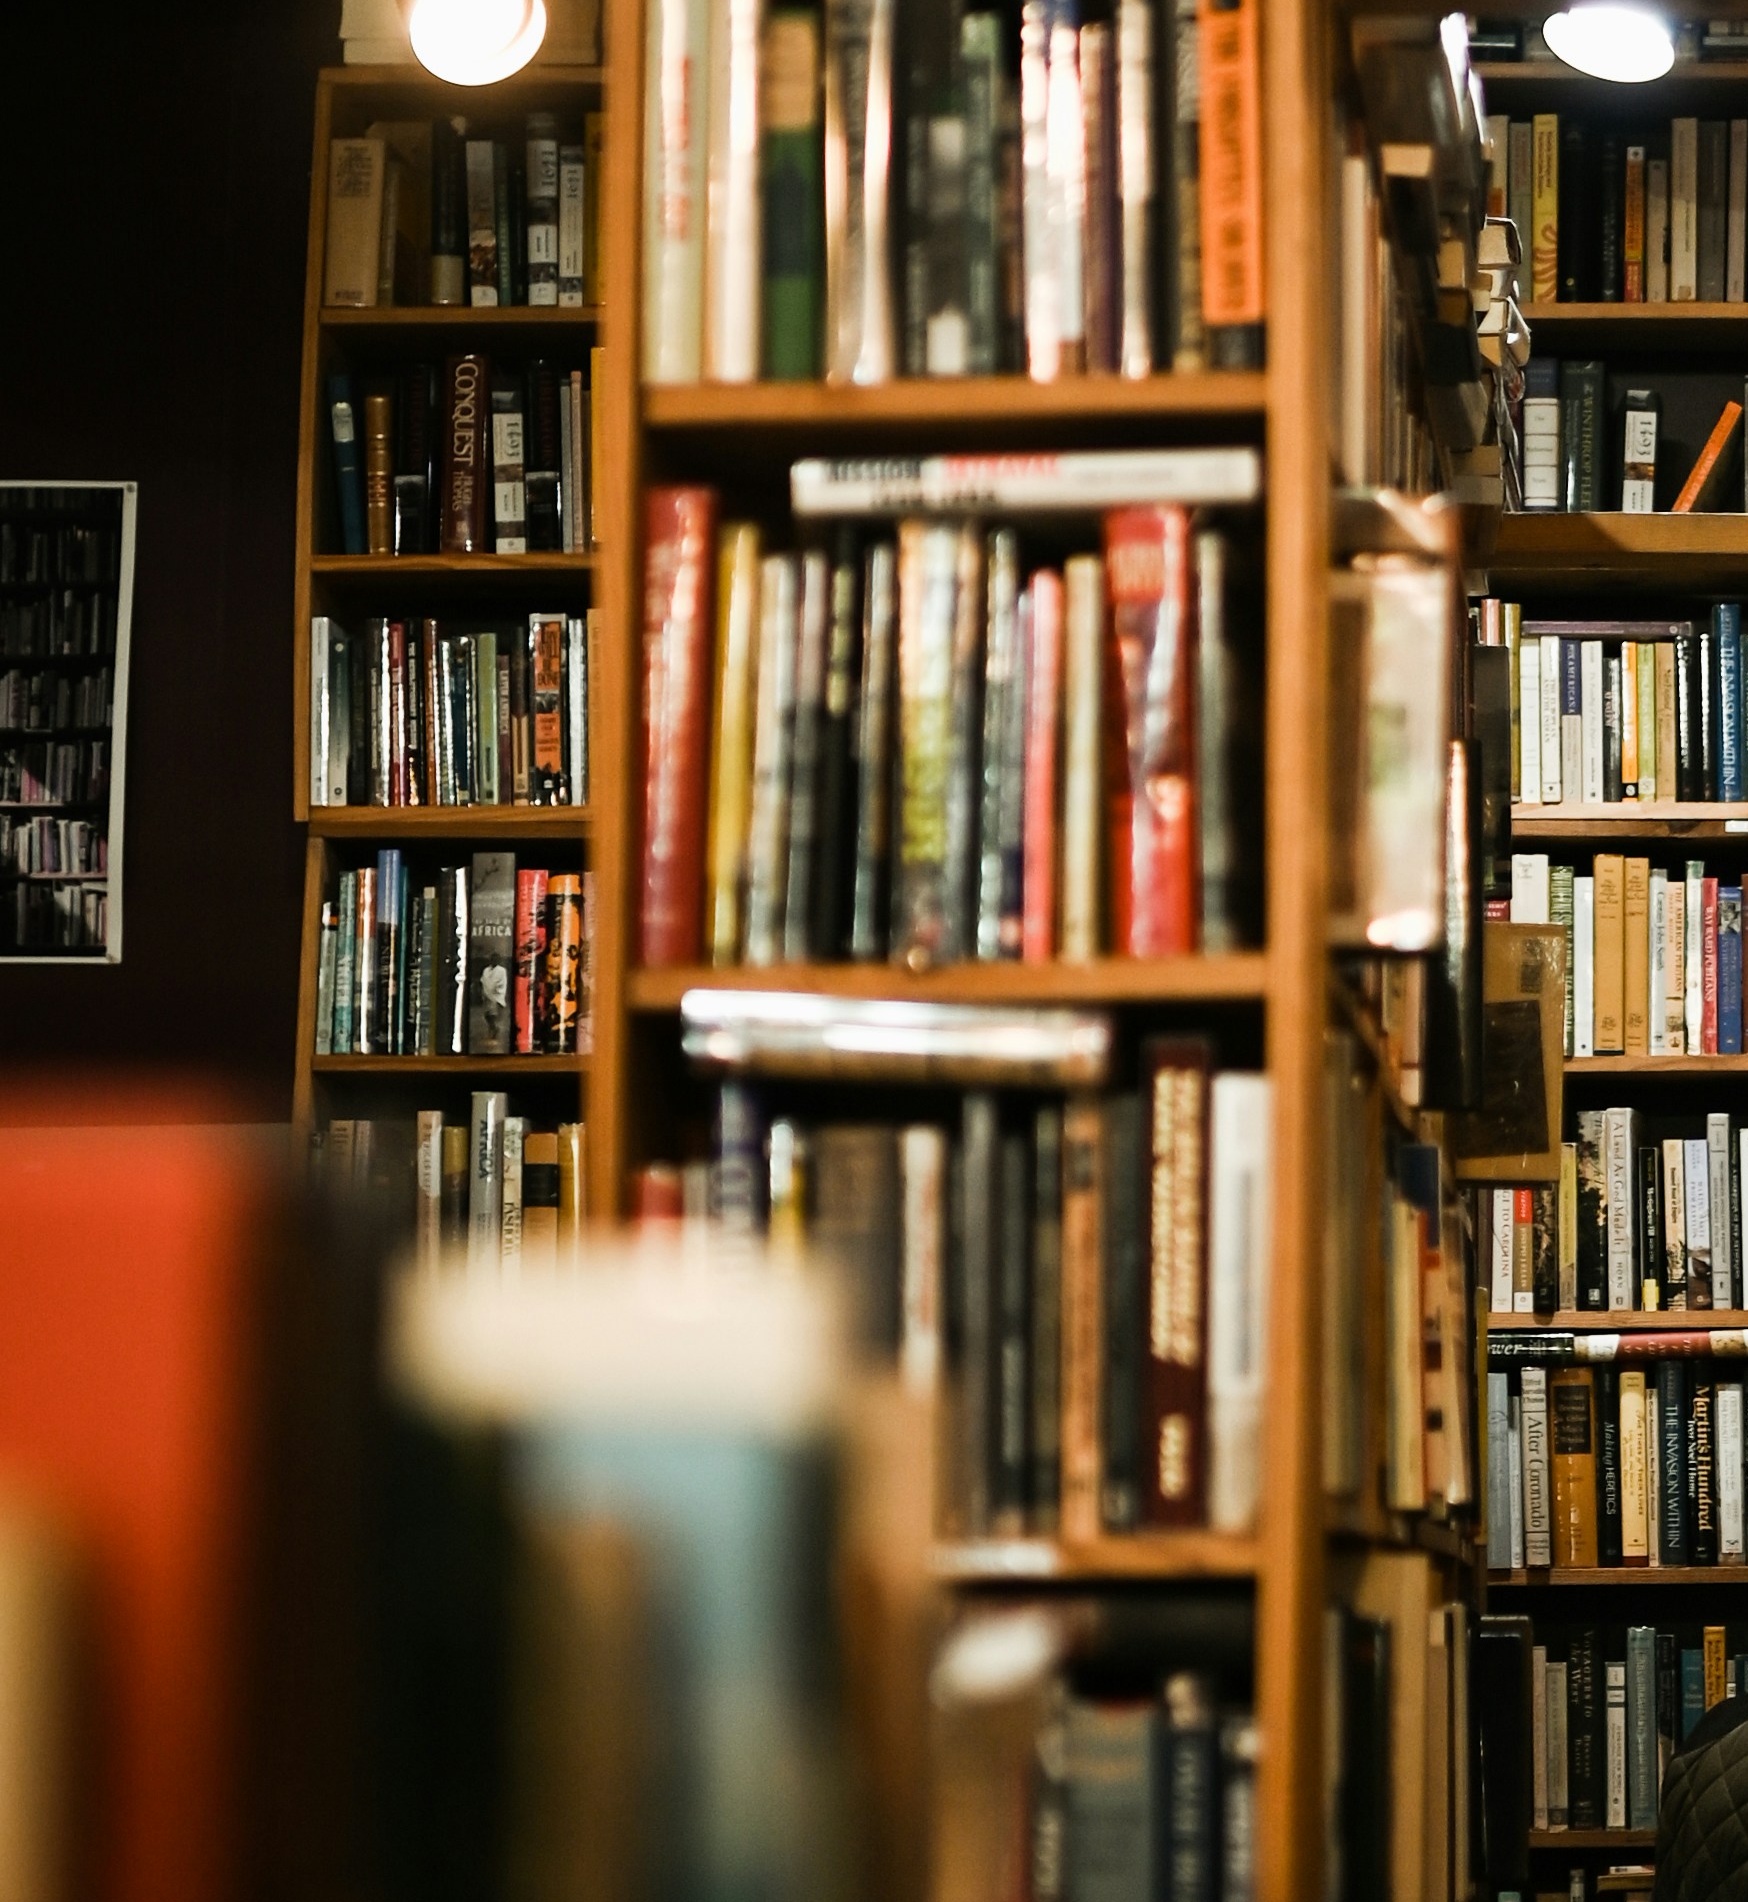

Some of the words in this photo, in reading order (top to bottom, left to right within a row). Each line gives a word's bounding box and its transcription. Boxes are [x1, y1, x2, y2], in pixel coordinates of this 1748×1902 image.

[452, 362, 479, 467] CONQUEST
[506, 421, 520, 458] 1493
[1581, 398, 1594, 473] WINTHROP
[1639, 420, 1653, 456] 1493
[452, 470, 464, 512] THOMAS
[1722, 646, 1735, 671] THE
[500, 670, 509, 696] LATIN
[1567, 660, 1576, 714] AMERICANA
[500, 698, 510, 735] AMERICA
[1551, 872, 1572, 925] WILDERNESS
[1656, 892, 1664, 923] Captain
[471, 924, 512, 938] AFRICA
[1656, 925, 1665, 944] John
[1675, 907, 1683, 952] AMERICAN
[1704, 906, 1713, 954] WAYWARD
[1657, 947, 1665, 971] Smith
[1675, 954, 1683, 992] PURITANS
[1705, 954, 1714, 1002] PURITANS
[1613, 1122, 1623, 1131] A
[479, 1120, 492, 1179] AFRICA
[1613, 1134, 1624, 1160] Land
[1613, 1164, 1623, 1179] As
[1613, 1183, 1623, 1202] God
[1501, 1207, 1510, 1221] TO
[1614, 1206, 1624, 1234] Made
[1501, 1224, 1511, 1278] CAROLINA
[1614, 1237, 1624, 1247] It
[1616, 1261, 1624, 1289] HORN
[1636, 1410, 1644, 1428] THE
[1665, 1404, 1678, 1429] THE
[1687, 1420, 1695, 1439] Ivor
[1693, 1386, 1711, 1454] Martin's
[1528, 1416, 1542, 1455] After
[1604, 1421, 1615, 1465] Making
[1636, 1433, 1644, 1456] TIMES
[1687, 1442, 1696, 1464] Noel
[1666, 1433, 1679, 1494] INVASION
[1528, 1459, 1545, 1528] Coronado
[1605, 1467, 1616, 1515] HERETICS
[1687, 1467, 1697, 1498] Hume
[1696, 1456, 1713, 1531] Hundred
[1667, 1497, 1680, 1548] WITHIN
[1571, 1642, 1580, 1663] the
[1583, 1631, 1594, 1698] VOYAGERS
[1571, 1669, 1582, 1705] WEST
[1583, 1705, 1593, 1718] to
